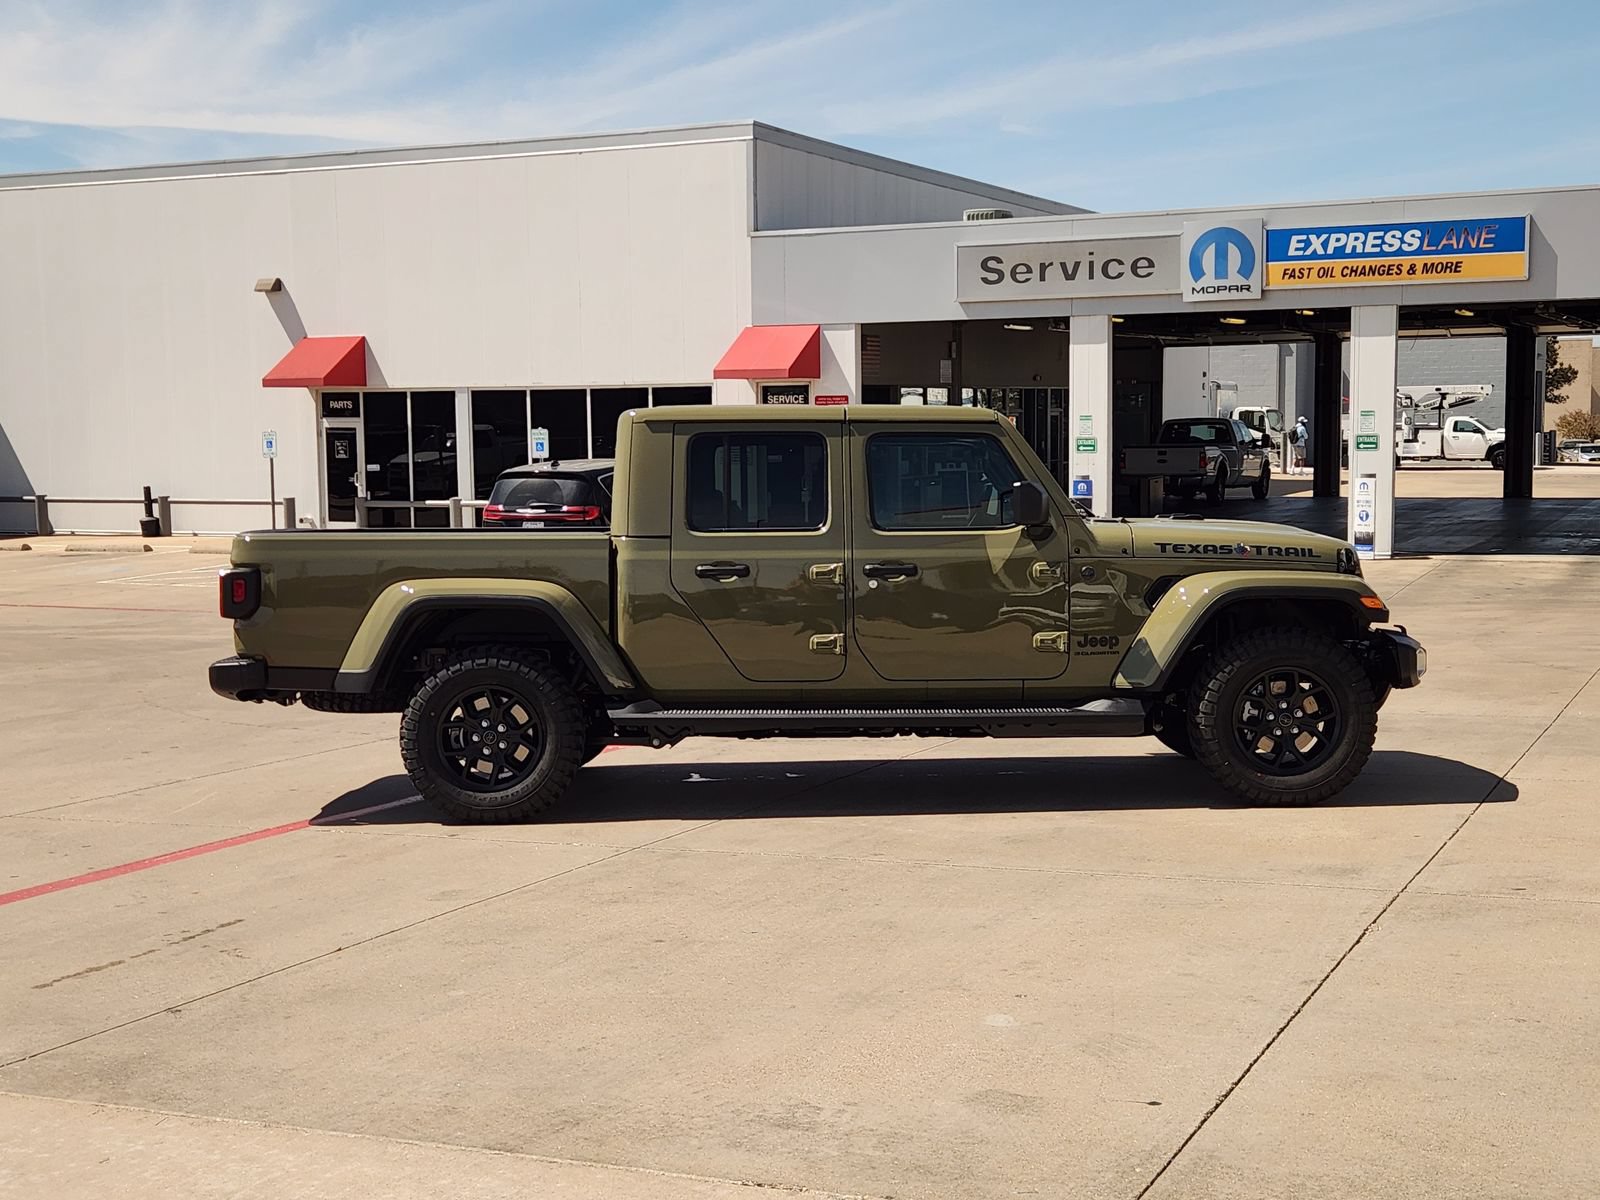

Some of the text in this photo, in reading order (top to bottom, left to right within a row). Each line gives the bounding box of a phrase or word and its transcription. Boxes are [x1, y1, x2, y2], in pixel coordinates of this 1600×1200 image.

[980, 252, 1156, 285] Service
[1281, 261, 1463, 280] FAST OIL CHANGES & MORE
[1191, 284, 1252, 295] MOPAR
[329, 400, 353, 409] PARTS
[767, 395, 805, 404] SERVICE
[1154, 542, 1322, 558] TEXAS TRAIL
[1077, 633, 1120, 650] Jeep
